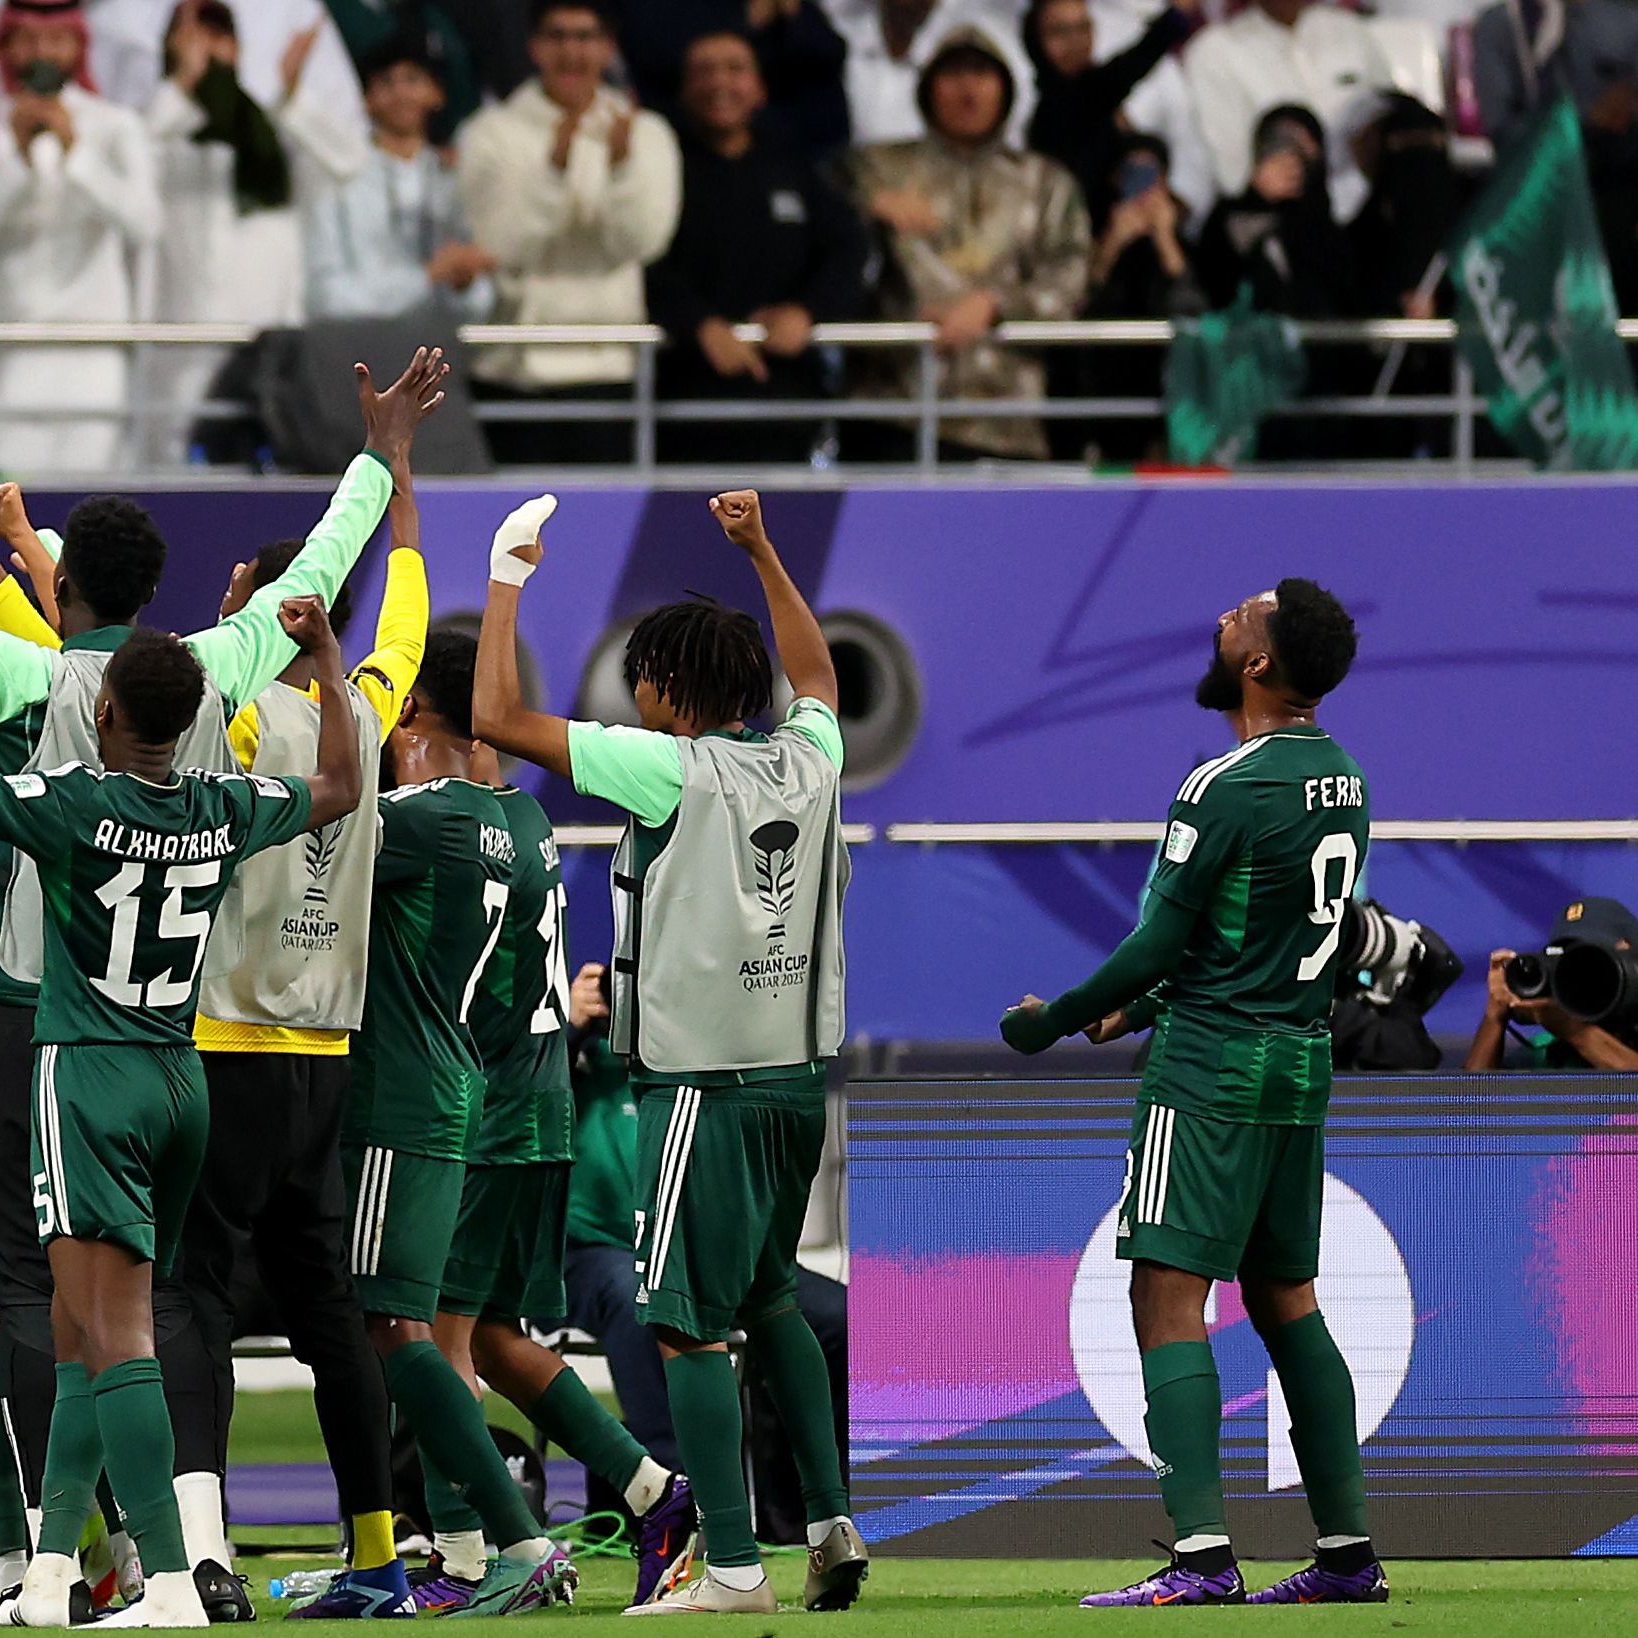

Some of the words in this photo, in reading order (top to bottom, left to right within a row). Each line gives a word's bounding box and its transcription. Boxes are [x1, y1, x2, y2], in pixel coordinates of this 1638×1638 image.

[1305, 775, 1362, 811] FERAS
[302, 907, 324, 920] AFC
[1297, 832, 1357, 980] 9
[89, 860, 221, 1007] 15
[281, 917, 320, 937] ASIAN
[459, 878, 509, 1023] 7
[767, 944, 785, 957] AFC
[739, 958, 782, 976] ASIAN
[784, 954, 807, 972] CUP
[744, 975, 779, 993] QATAR
